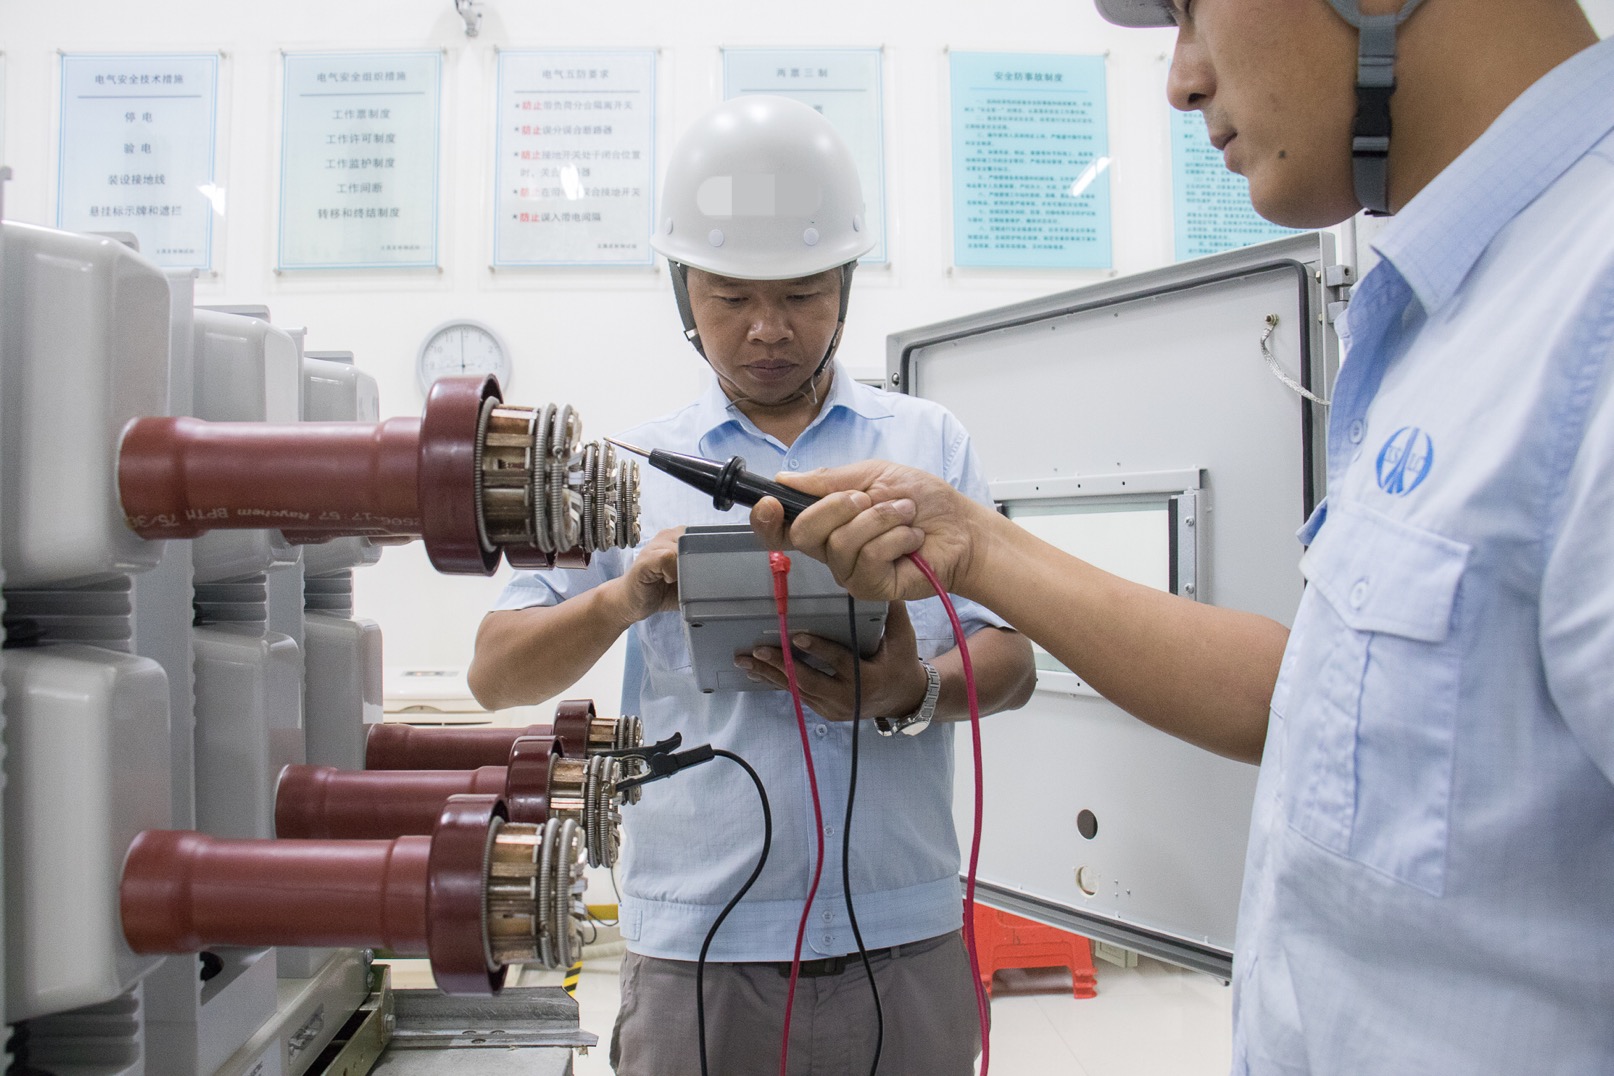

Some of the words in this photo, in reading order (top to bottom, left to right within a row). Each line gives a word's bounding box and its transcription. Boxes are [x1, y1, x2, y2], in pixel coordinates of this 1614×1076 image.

[95, 74, 184, 85] 电气安全技术措施
[317, 71, 407, 83] 电气安全组织措施
[542, 68, 610, 80] 电气五防要求
[994, 71, 1063, 82] 安全防事故制度
[332, 109, 391, 120] 工作票制度
[326, 133, 396, 145] 工作许可制度
[325, 158, 396, 170] 工作监护制度
[107, 174, 166, 186] 装设接地线
[336, 182, 383, 194] 工作间断
[318, 207, 400, 219] 转移和终结制度
[237, 508, 310, 520] Raychem
